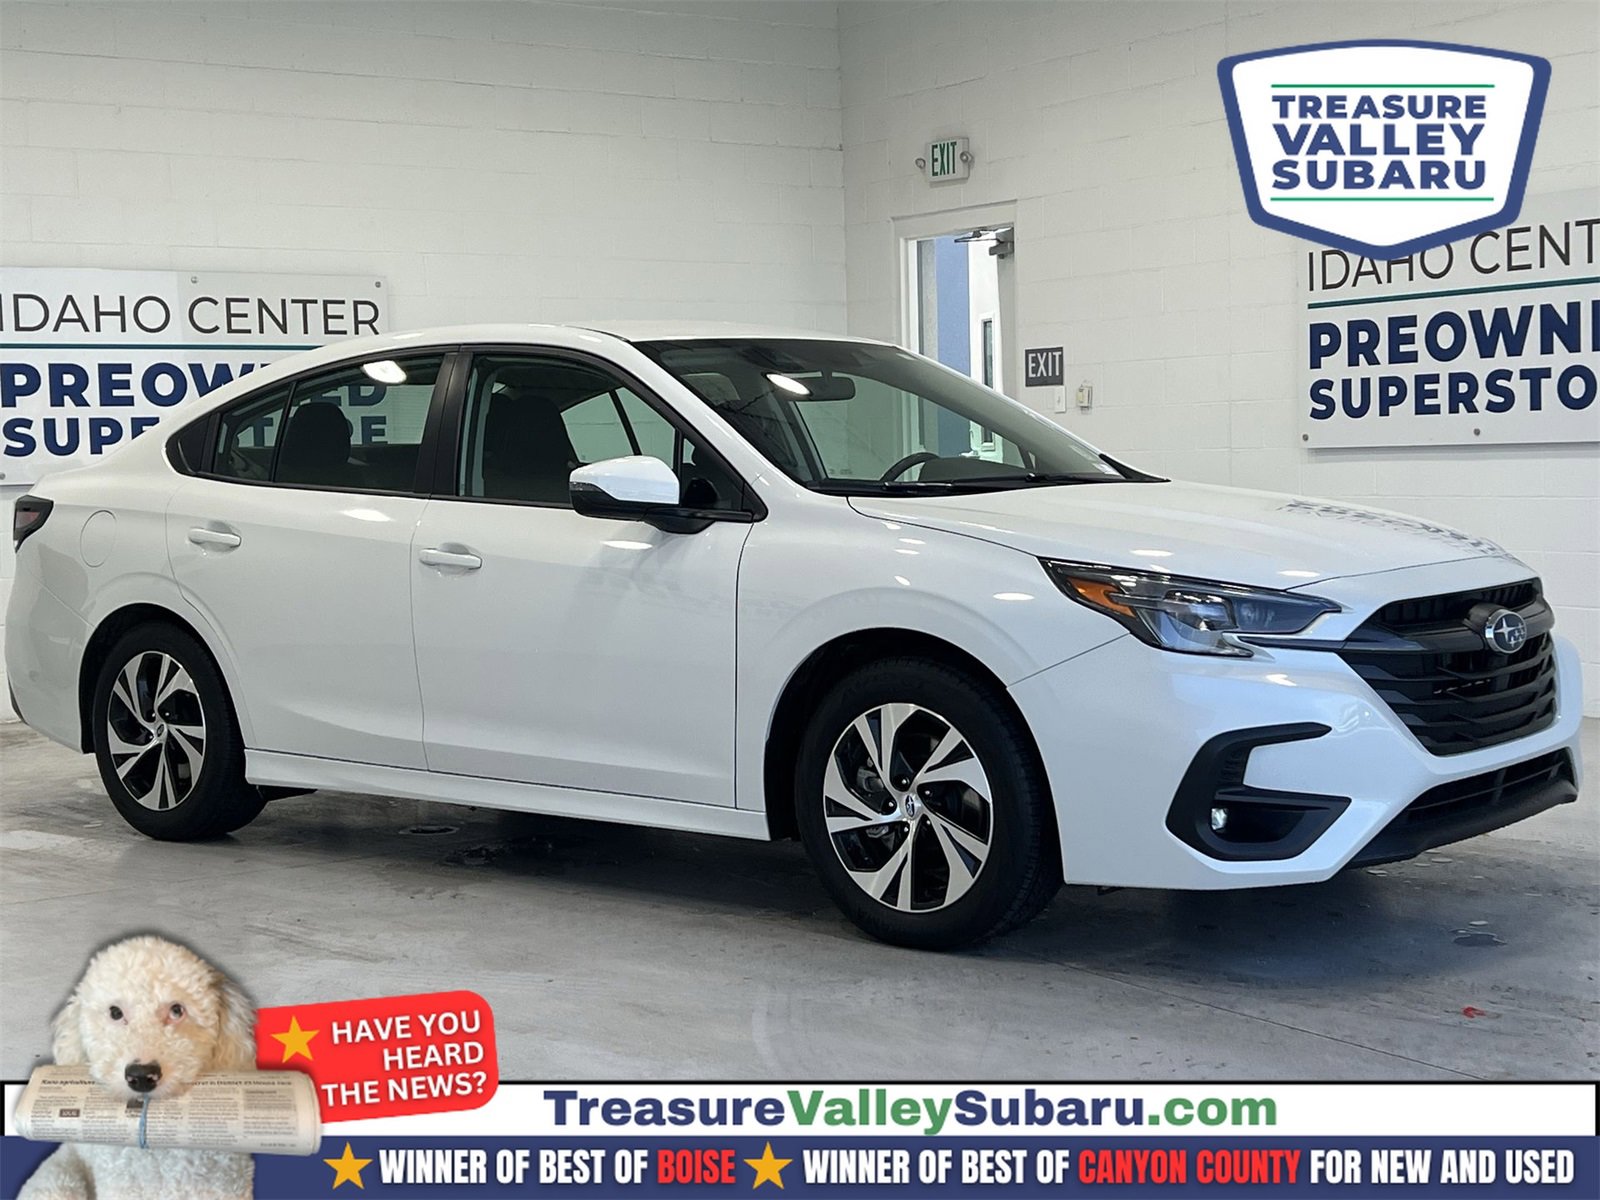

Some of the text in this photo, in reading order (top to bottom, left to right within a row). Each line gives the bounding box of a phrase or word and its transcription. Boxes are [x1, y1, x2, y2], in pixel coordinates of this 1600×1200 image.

[931, 141, 957, 176] EXIT
[1308, 218, 1600, 292] IDAHO CENT
[188, 297, 380, 335] CENTER
[1309, 299, 1600, 369] PREOWN
[1028, 352, 1062, 378] EXIT
[1309, 364, 1598, 420] SUPERSTO
